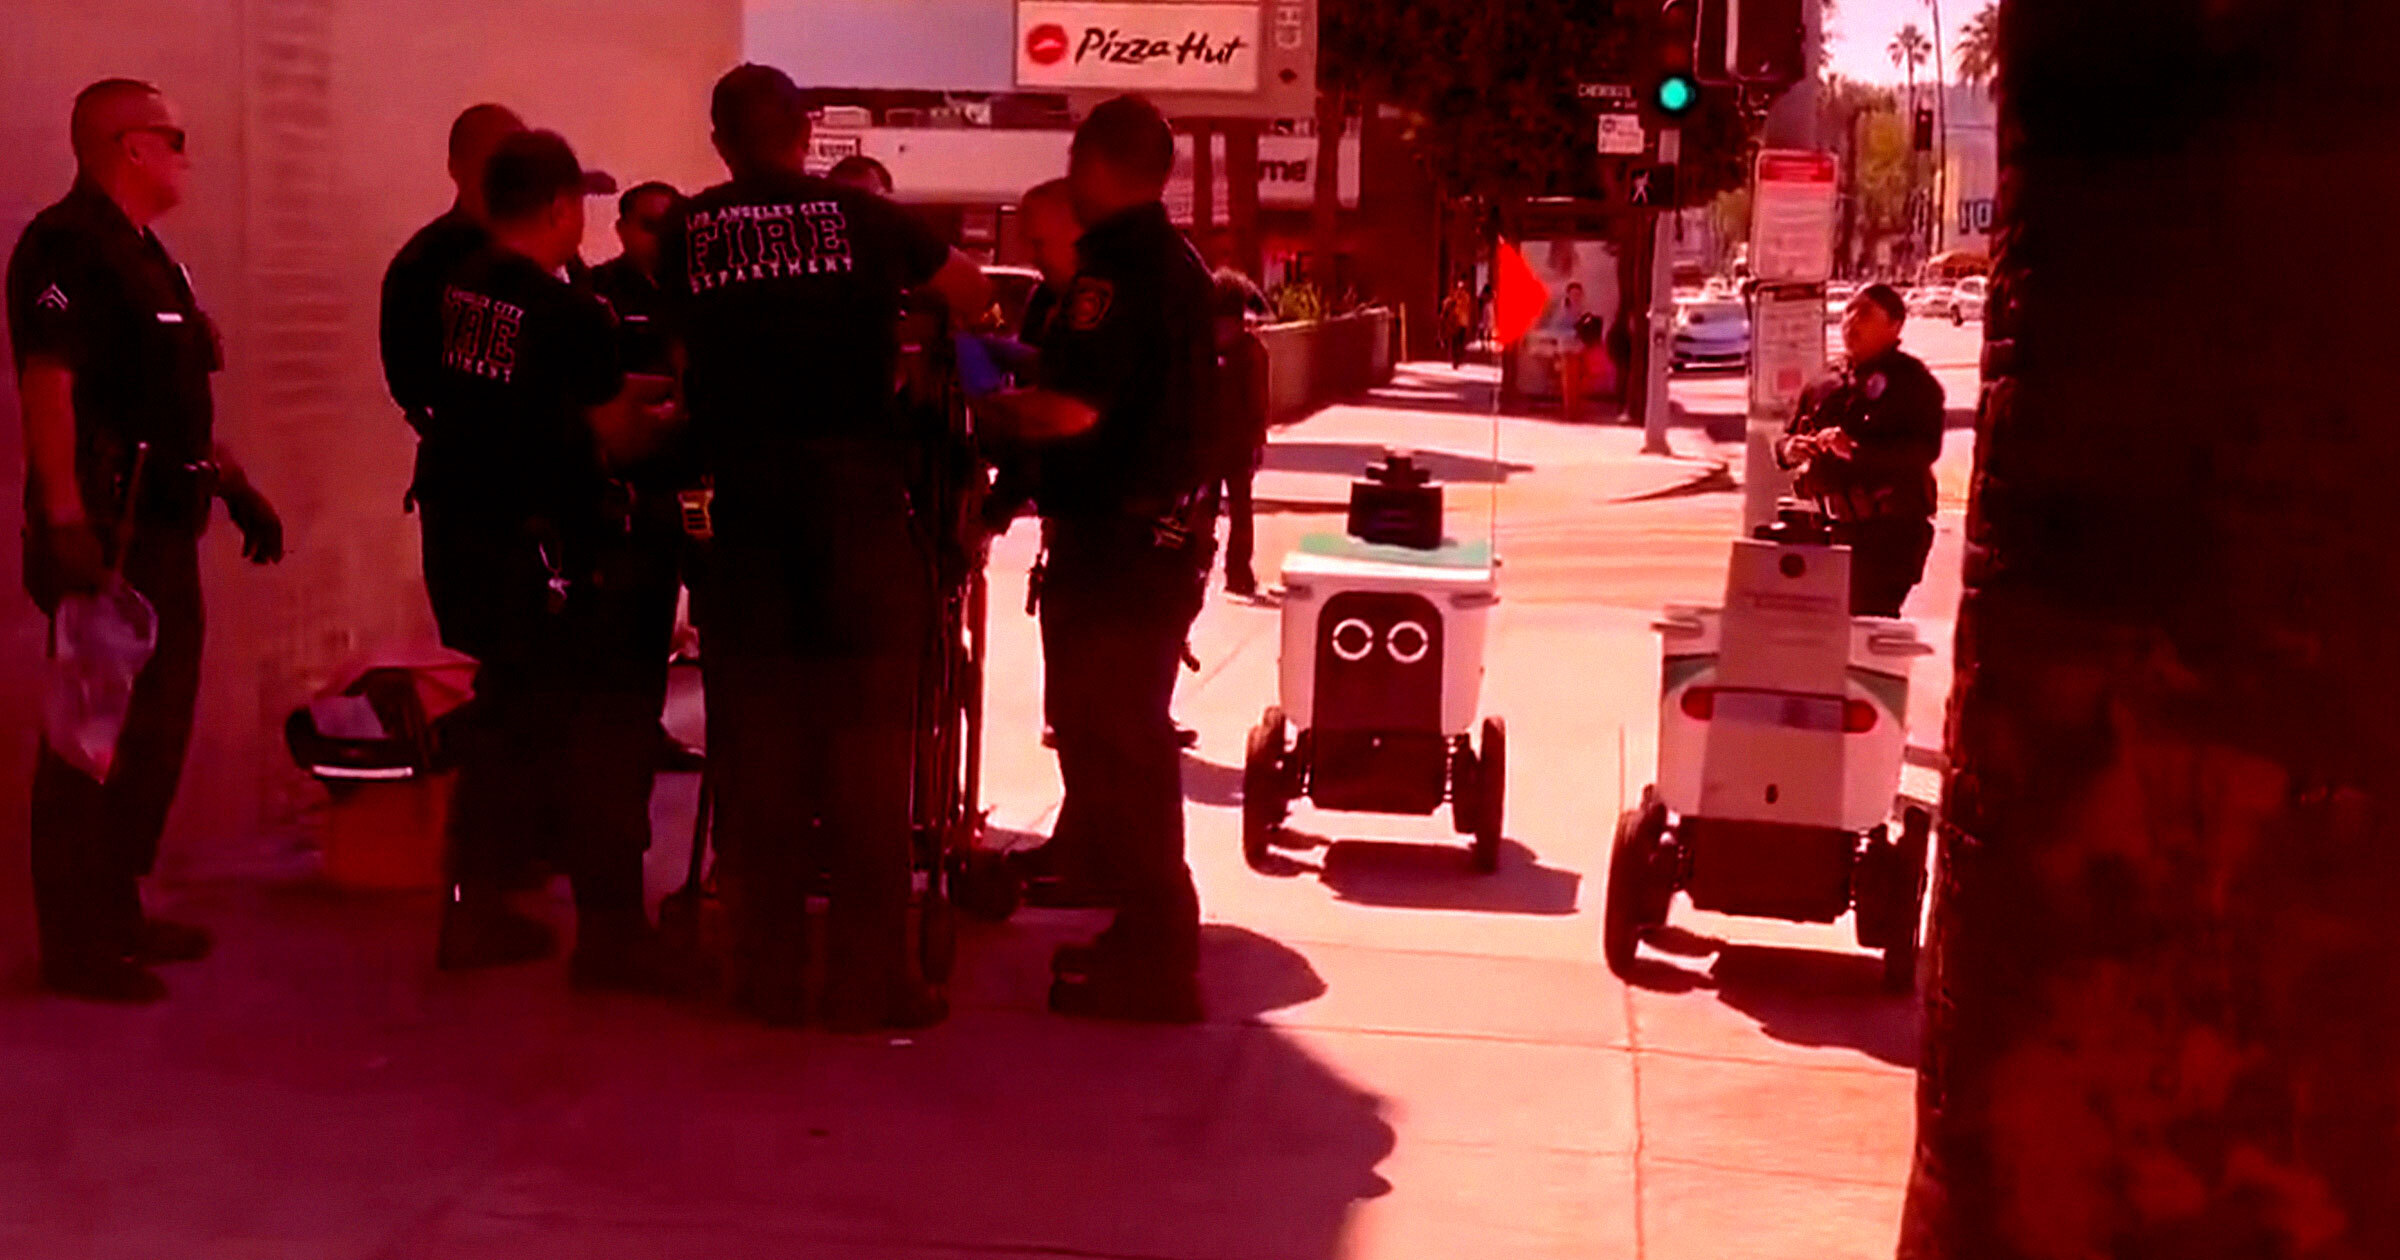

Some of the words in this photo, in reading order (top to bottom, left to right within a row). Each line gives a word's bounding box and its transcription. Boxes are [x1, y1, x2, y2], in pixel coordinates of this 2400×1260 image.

[1075, 27, 1171, 64] Pizza
[1169, 31, 1249, 64] Hut
[800, 201, 840, 216] CITY
[686, 211, 851, 277] FIRE
[689, 257, 853, 294] DEPARTMENT
